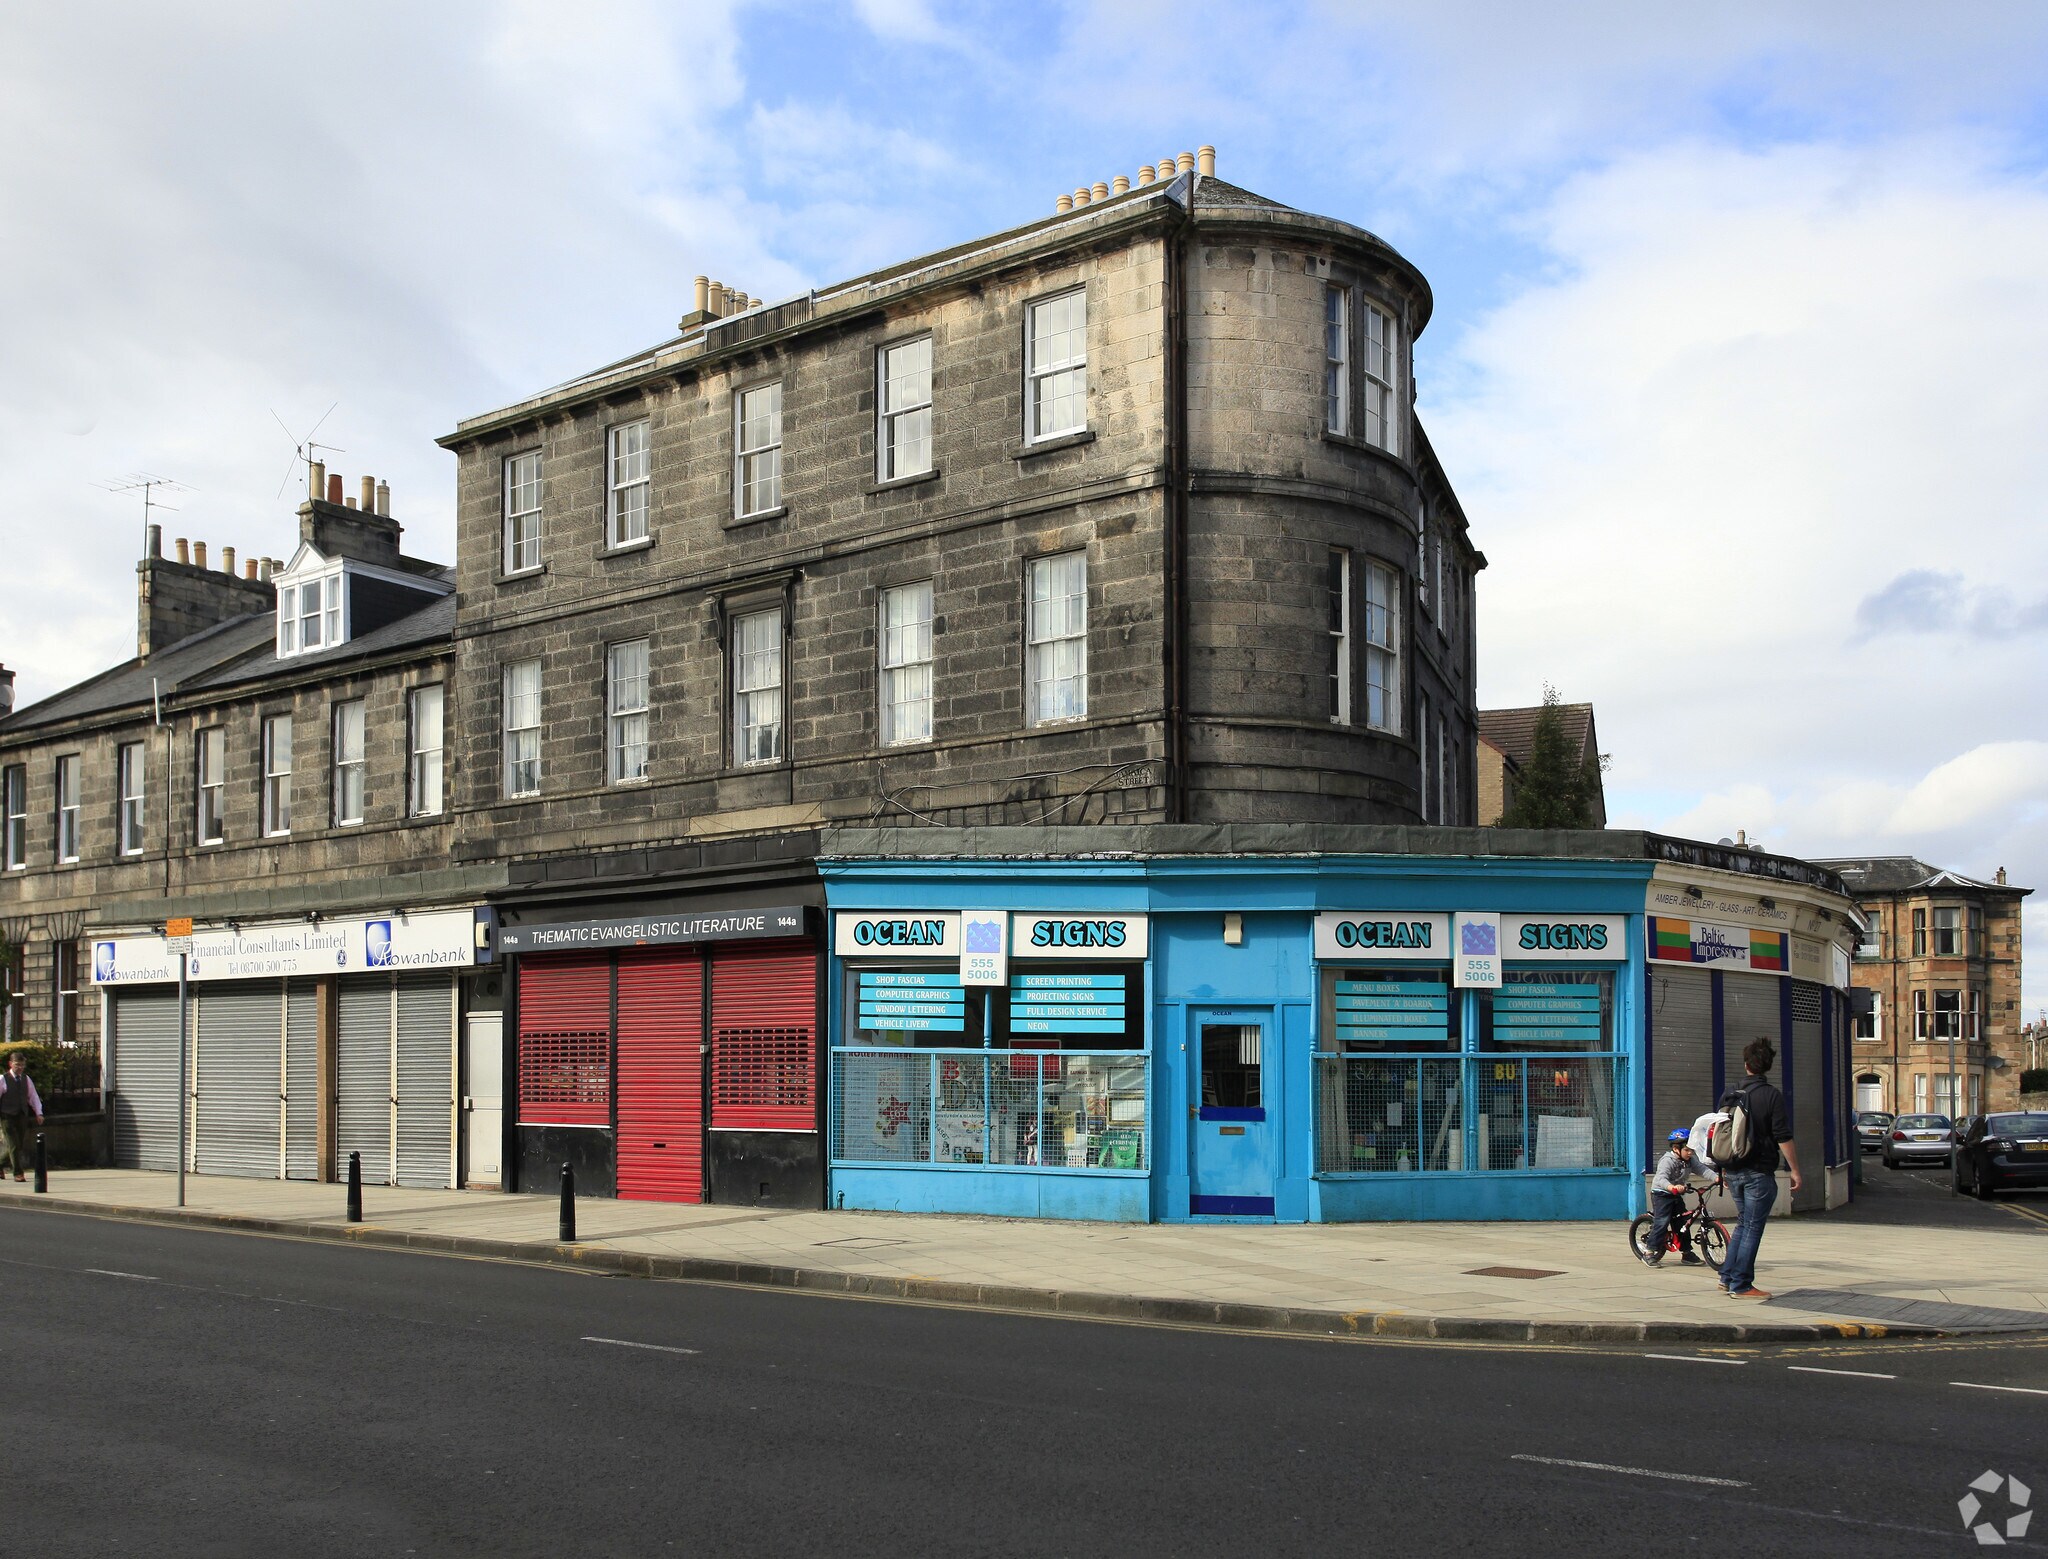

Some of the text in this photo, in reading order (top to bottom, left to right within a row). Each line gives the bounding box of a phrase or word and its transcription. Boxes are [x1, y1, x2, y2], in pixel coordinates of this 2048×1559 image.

[1118, 776, 1150, 786] STREET
[1655, 893, 1788, 920] AMBER JEWELLERY GLASS ART CERAMICS
[777, 917, 797, 927] 144a
[532, 916, 765, 944] THEMATIC EVANGELISTIC LITERATURE
[854, 920, 946, 946] OCEAN
[1031, 920, 1126, 947] SIGNS
[1335, 921, 1432, 948] OCEAN
[503, 936, 519, 944] 144a
[1519, 923, 1608, 950] SIGNS
[1701, 926, 1726, 945] Baltic
[190, 938, 236, 958] Financial
[239, 935, 300, 955] Consultants
[304, 930, 346, 950] Limited
[1696, 939, 1746, 962] Impressions
[228, 959, 297, 974] Tel 08700 500 775
[970, 958, 994, 969] 555
[1468, 960, 1491, 970] 555
[966, 969, 998, 980] 5006
[1464, 971, 1496, 982] 5006
[875, 976, 925, 985] SHOP FASCIAS
[1026, 977, 1092, 986] SCREEN PRINTING
[1352, 984, 1400, 992] MENU BOXES
[1508, 986, 1556, 994] SHOP FASCIAS
[875, 990, 951, 1000] COMPUTER GRAPHICS
[1026, 992, 1095, 1001] PROJECTING SIGNS
[1352, 999, 1391, 1007] PAVEMENT
[1403, 999, 1433, 1008] BOARDS
[1508, 1000, 1582, 1009] COMPUTER GRAPHICS
[875, 1004, 946, 1014] WINDOW LETTERING
[1026, 1007, 1107, 1016] FULL DESIGN SERVICE
[1353, 1014, 1428, 1023] ILLUMINATED BOXES
[1508, 1015, 1579, 1023] WINDOW LETTERING
[875, 1019, 930, 1029] VEHICLE LIVERY
[1027, 1022, 1049, 1031] NEON
[1353, 1029, 1388, 1038] BANNERS
[1509, 1030, 1564, 1038] VEHICLE LIVERY
